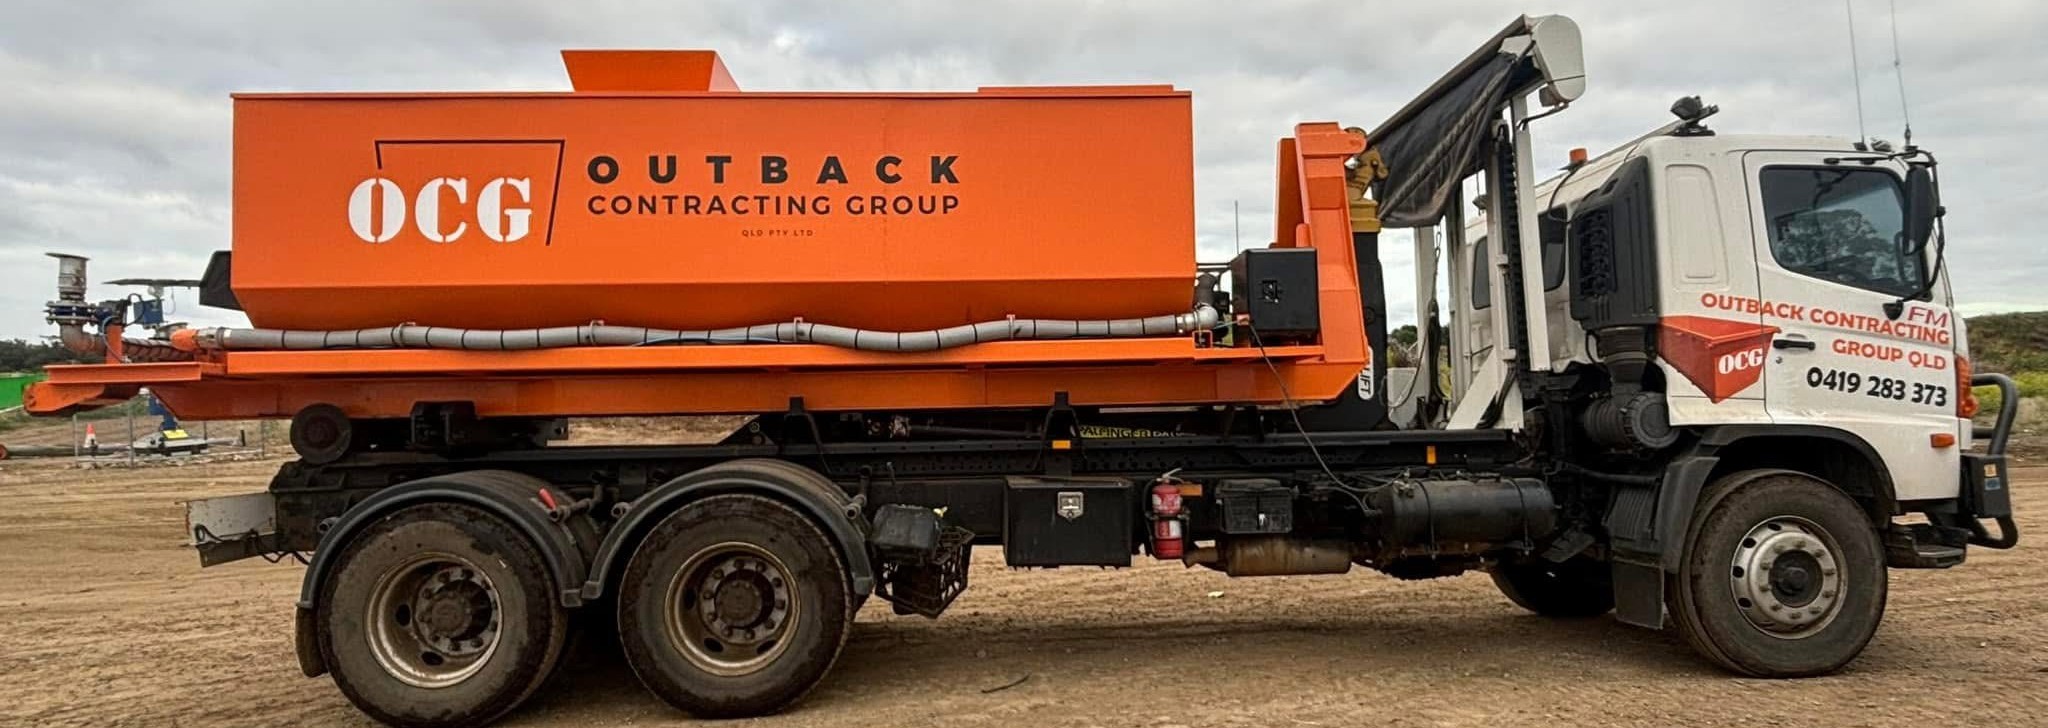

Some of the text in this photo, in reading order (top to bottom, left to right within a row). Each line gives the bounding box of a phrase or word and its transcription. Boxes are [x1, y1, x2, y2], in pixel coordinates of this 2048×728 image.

[587, 155, 960, 184] OUTBACK
[348, 177, 532, 243] OCG
[588, 195, 959, 215] CONTRACTING GROUP
[742, 229, 813, 237] QLD PTY LTD
[1701, 293, 1950, 345] OUTBACK CONTRACTING
[1907, 306, 1948, 327] FM
[1718, 348, 1763, 374] OCG
[1832, 339, 1946, 370] GROUP QLD
[1807, 366, 1947, 407] 0419 283 373
